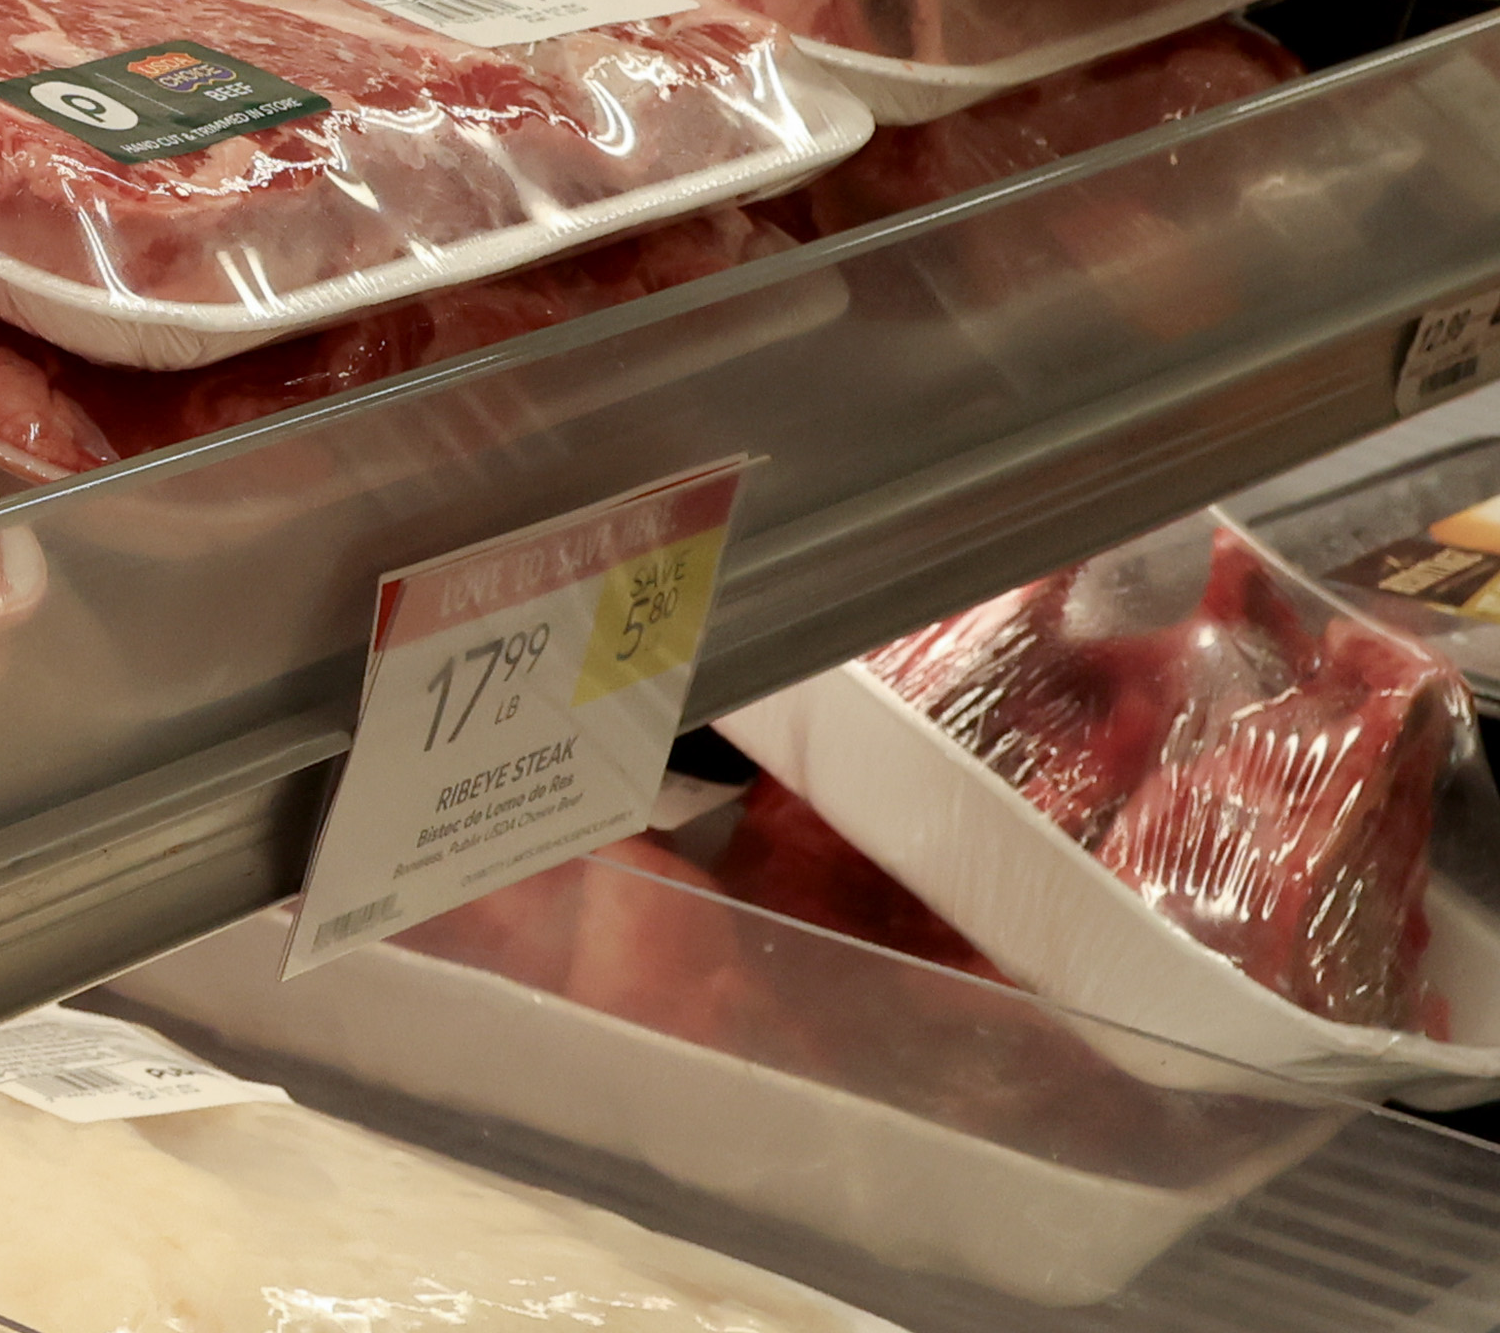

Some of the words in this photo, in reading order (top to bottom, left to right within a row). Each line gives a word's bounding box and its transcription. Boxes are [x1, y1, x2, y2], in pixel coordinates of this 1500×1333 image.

[139, 54, 190, 74] USDA
[204, 81, 254, 103] BEEF
[120, 137, 160, 154] HAND
[158, 134, 184, 148] CUT
[185, 131, 197, 141] &
[196, 114, 250, 137] TRIMMED
[246, 109, 261, 122] IN
[260, 96, 302, 116] STORE
[631, 550, 687, 593] SAVE
[494, 695, 519, 724] LB
[435, 757, 510, 812] RIBEYE
[514, 737, 579, 779] STEAK
[417, 818, 461, 849] Bistec
